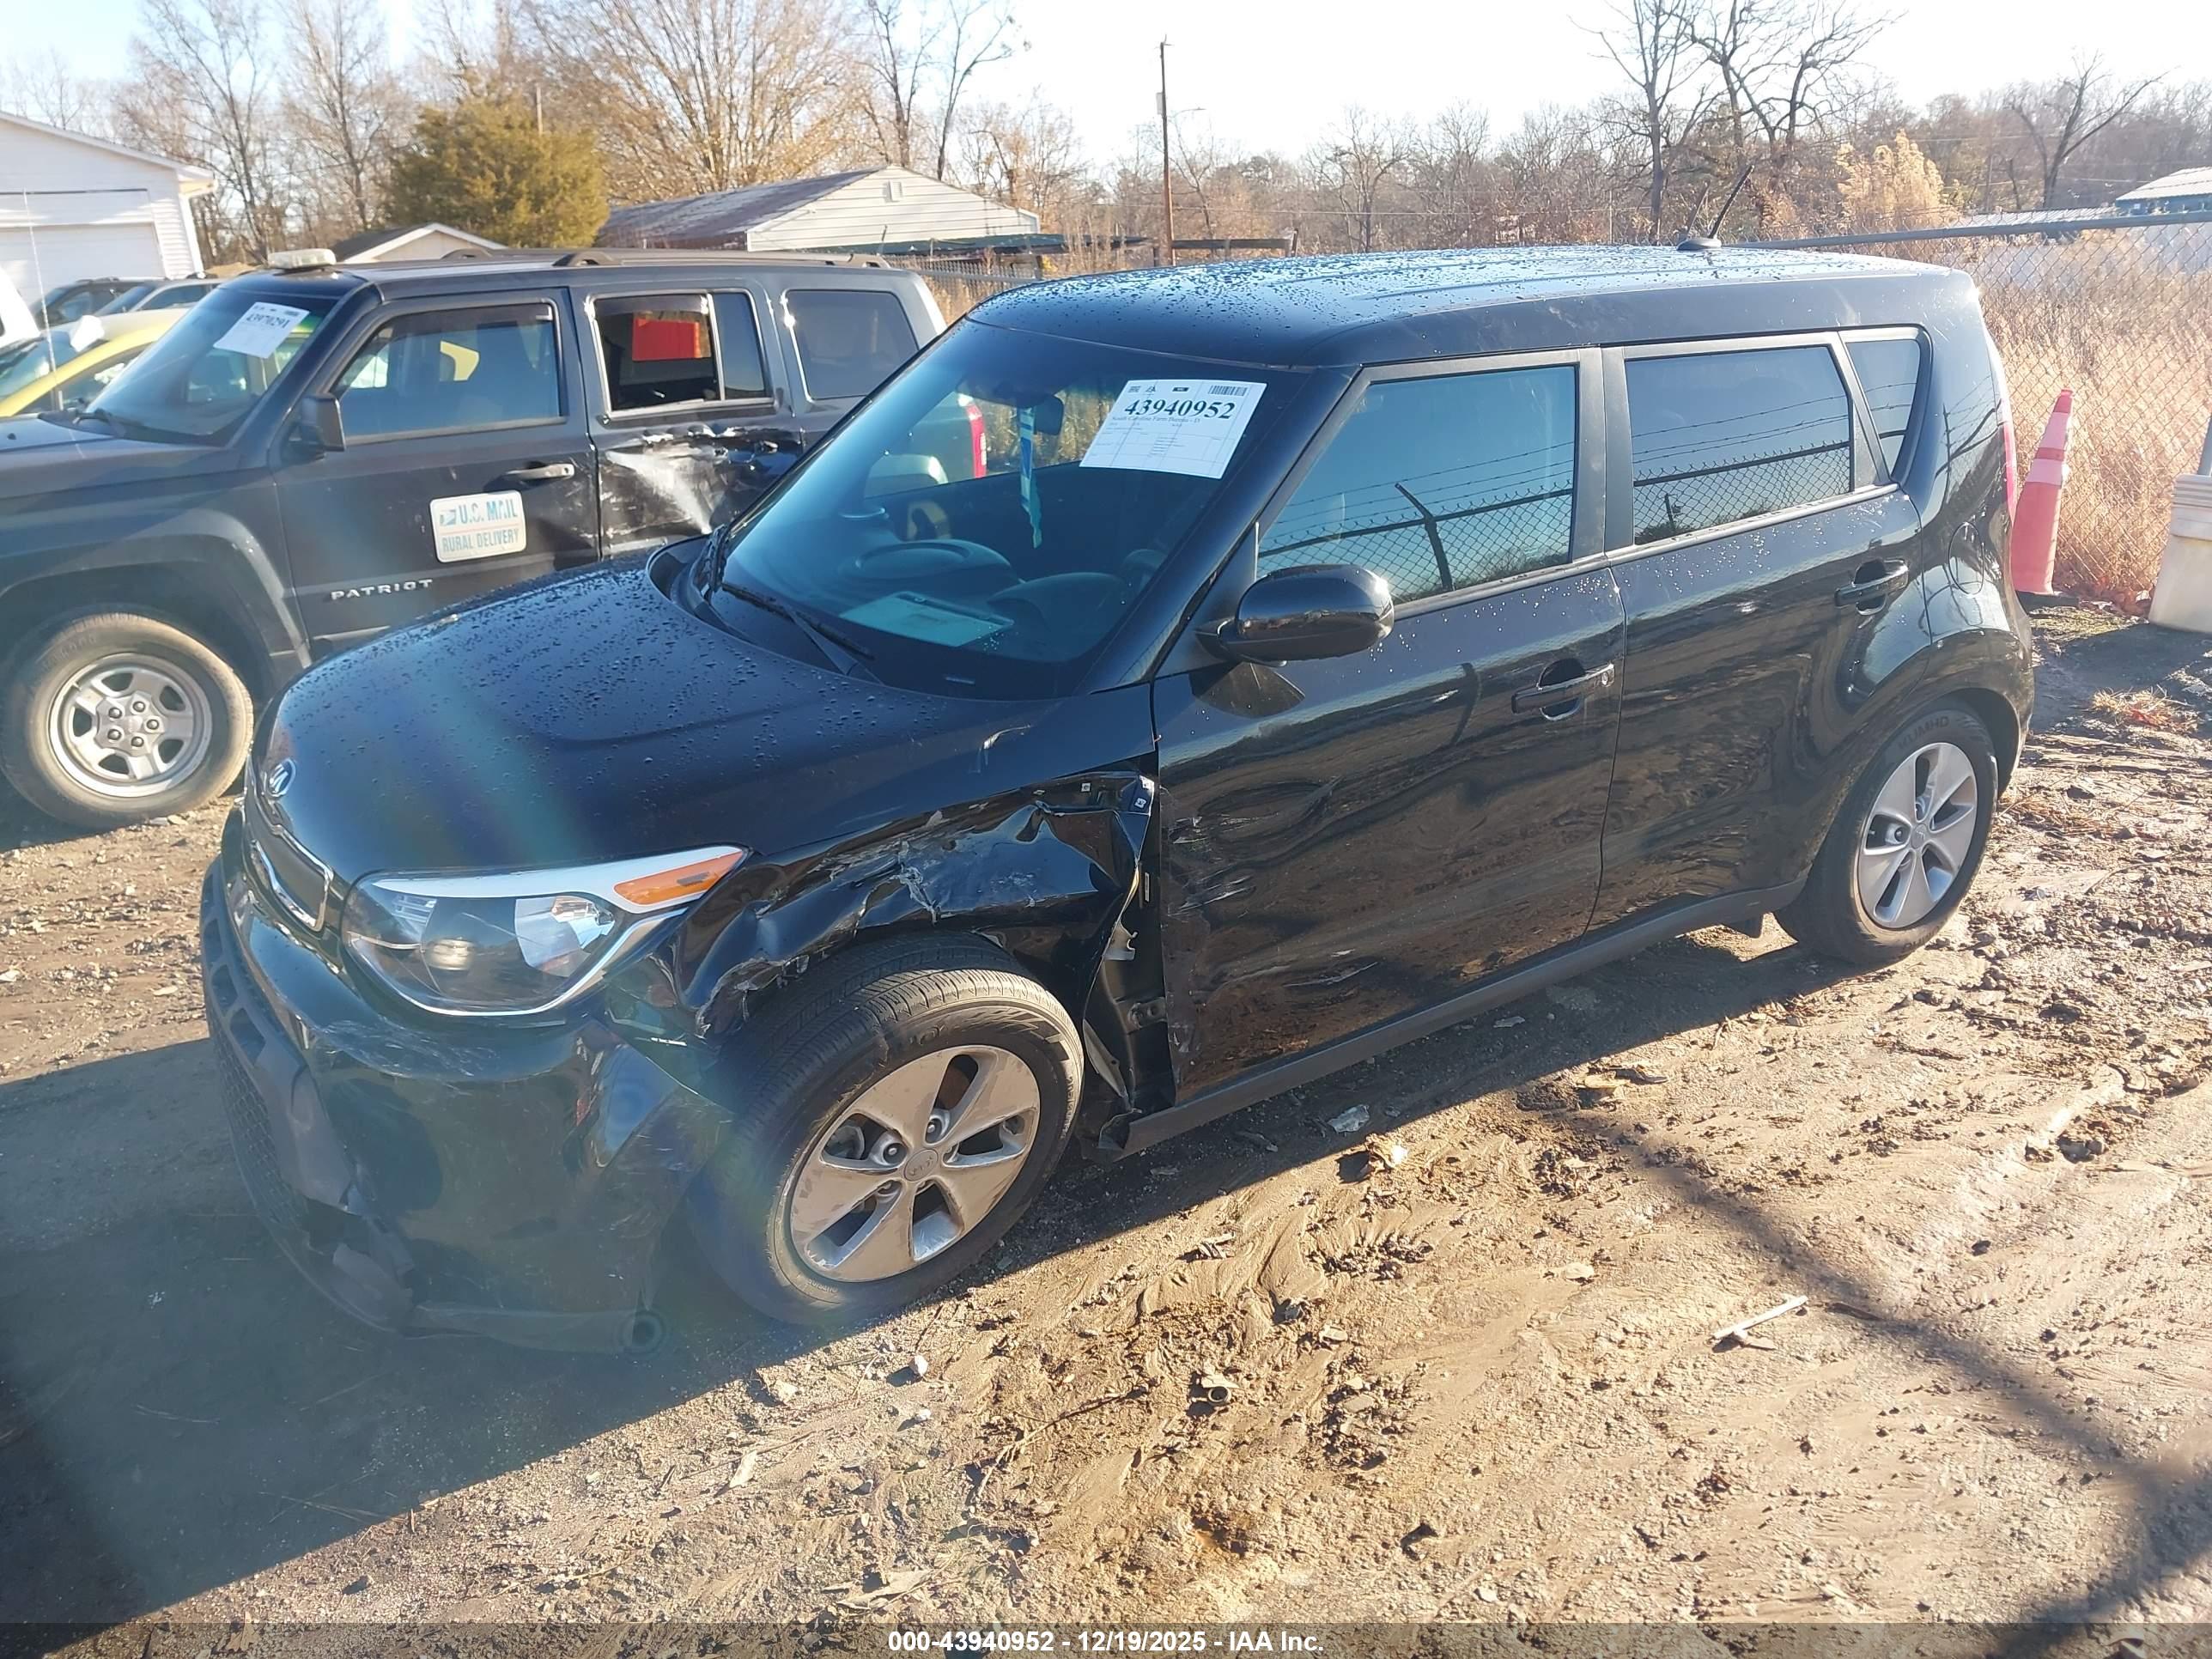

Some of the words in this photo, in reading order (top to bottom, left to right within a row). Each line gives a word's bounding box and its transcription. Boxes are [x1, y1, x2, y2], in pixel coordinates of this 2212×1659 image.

[1124, 398, 1236, 420] 43940952
[441, 534, 474, 553] RURAL
[477, 528, 520, 549] DELIVERY
[331, 579, 433, 601] PATRIOT
